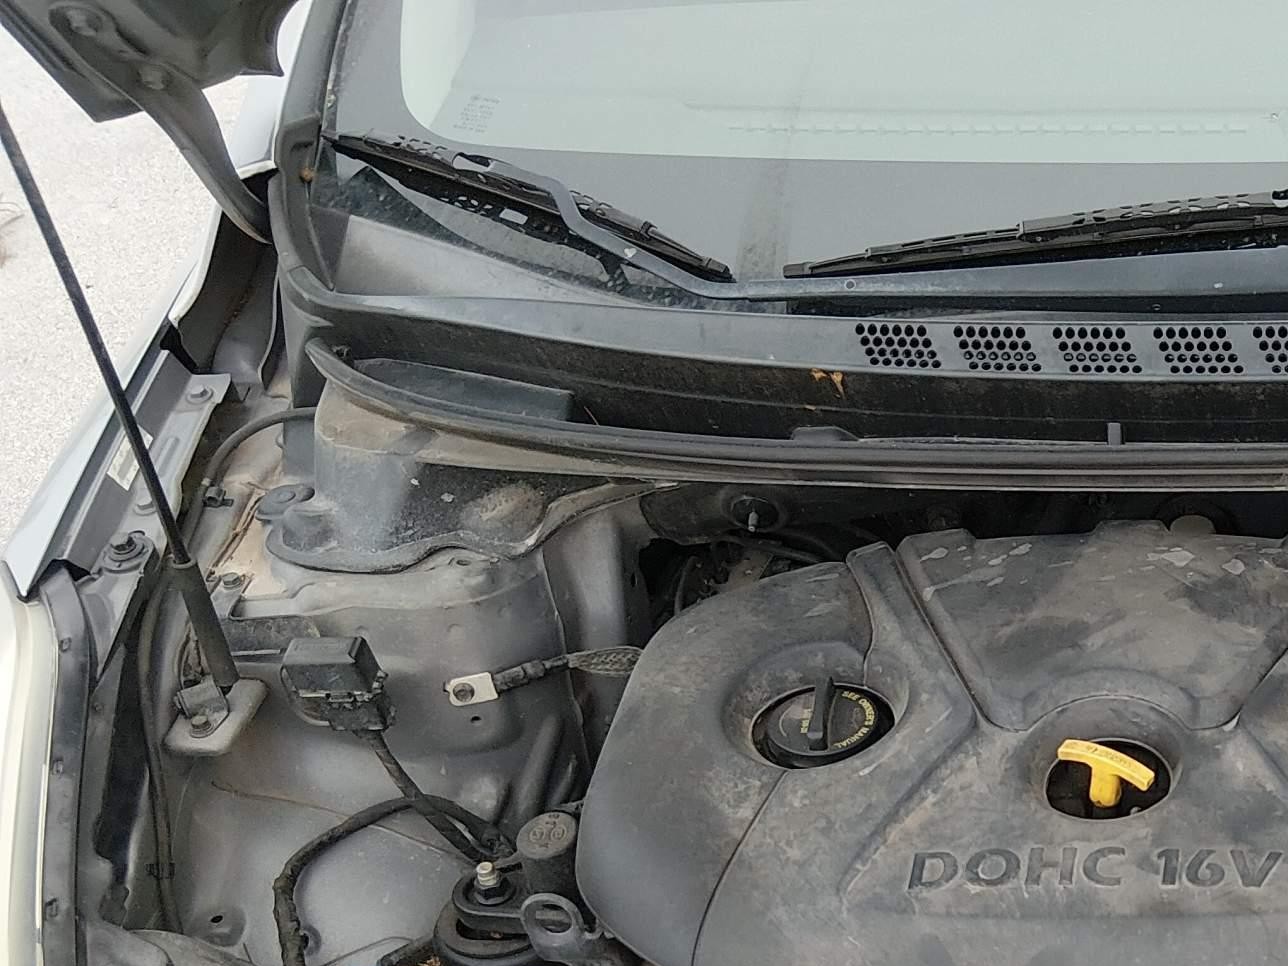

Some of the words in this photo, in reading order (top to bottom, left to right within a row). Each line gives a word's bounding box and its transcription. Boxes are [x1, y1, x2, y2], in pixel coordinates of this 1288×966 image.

[841, 690, 860, 701] SEE
[833, 726, 870, 749] MANUAL
[908, 847, 1125, 891] DOHC
[1158, 847, 1285, 889] 16V
